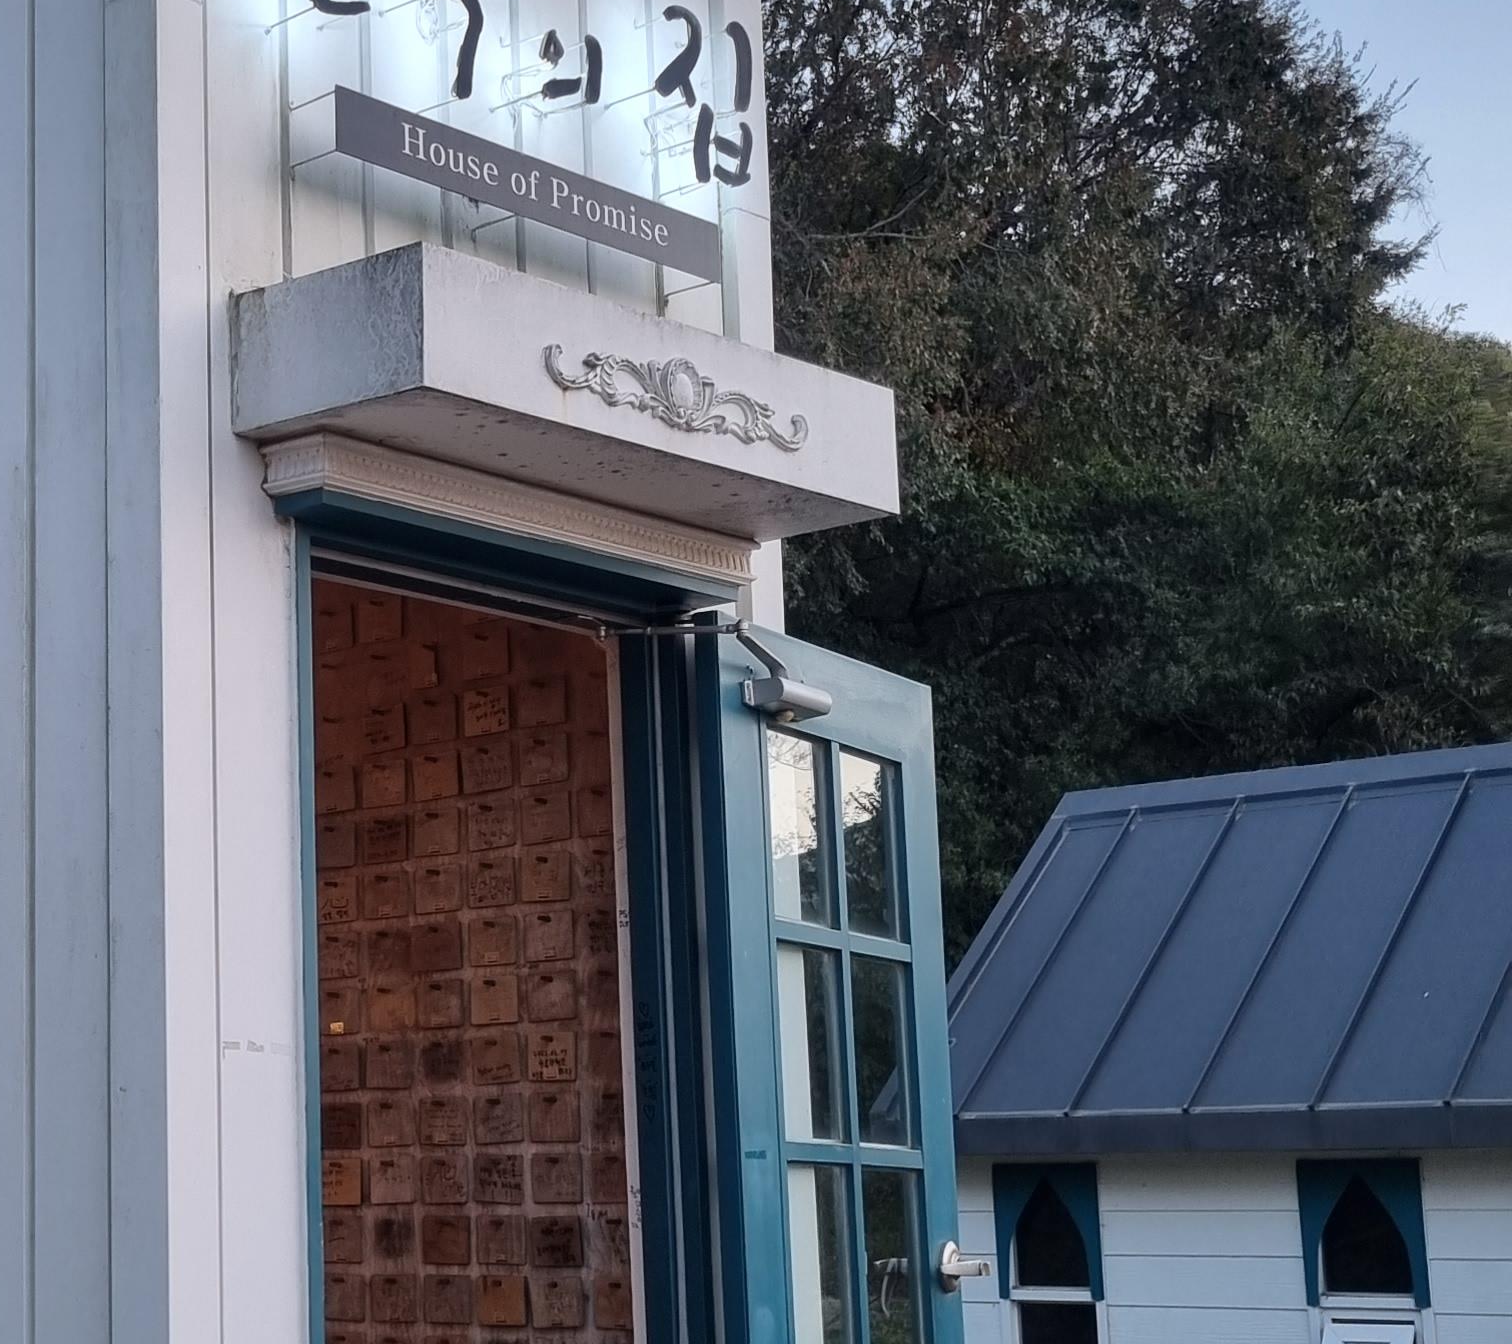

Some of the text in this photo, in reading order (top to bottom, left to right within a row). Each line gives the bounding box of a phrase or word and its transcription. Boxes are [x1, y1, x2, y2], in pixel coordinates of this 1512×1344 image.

[401, 122, 670, 247] House of Promise
